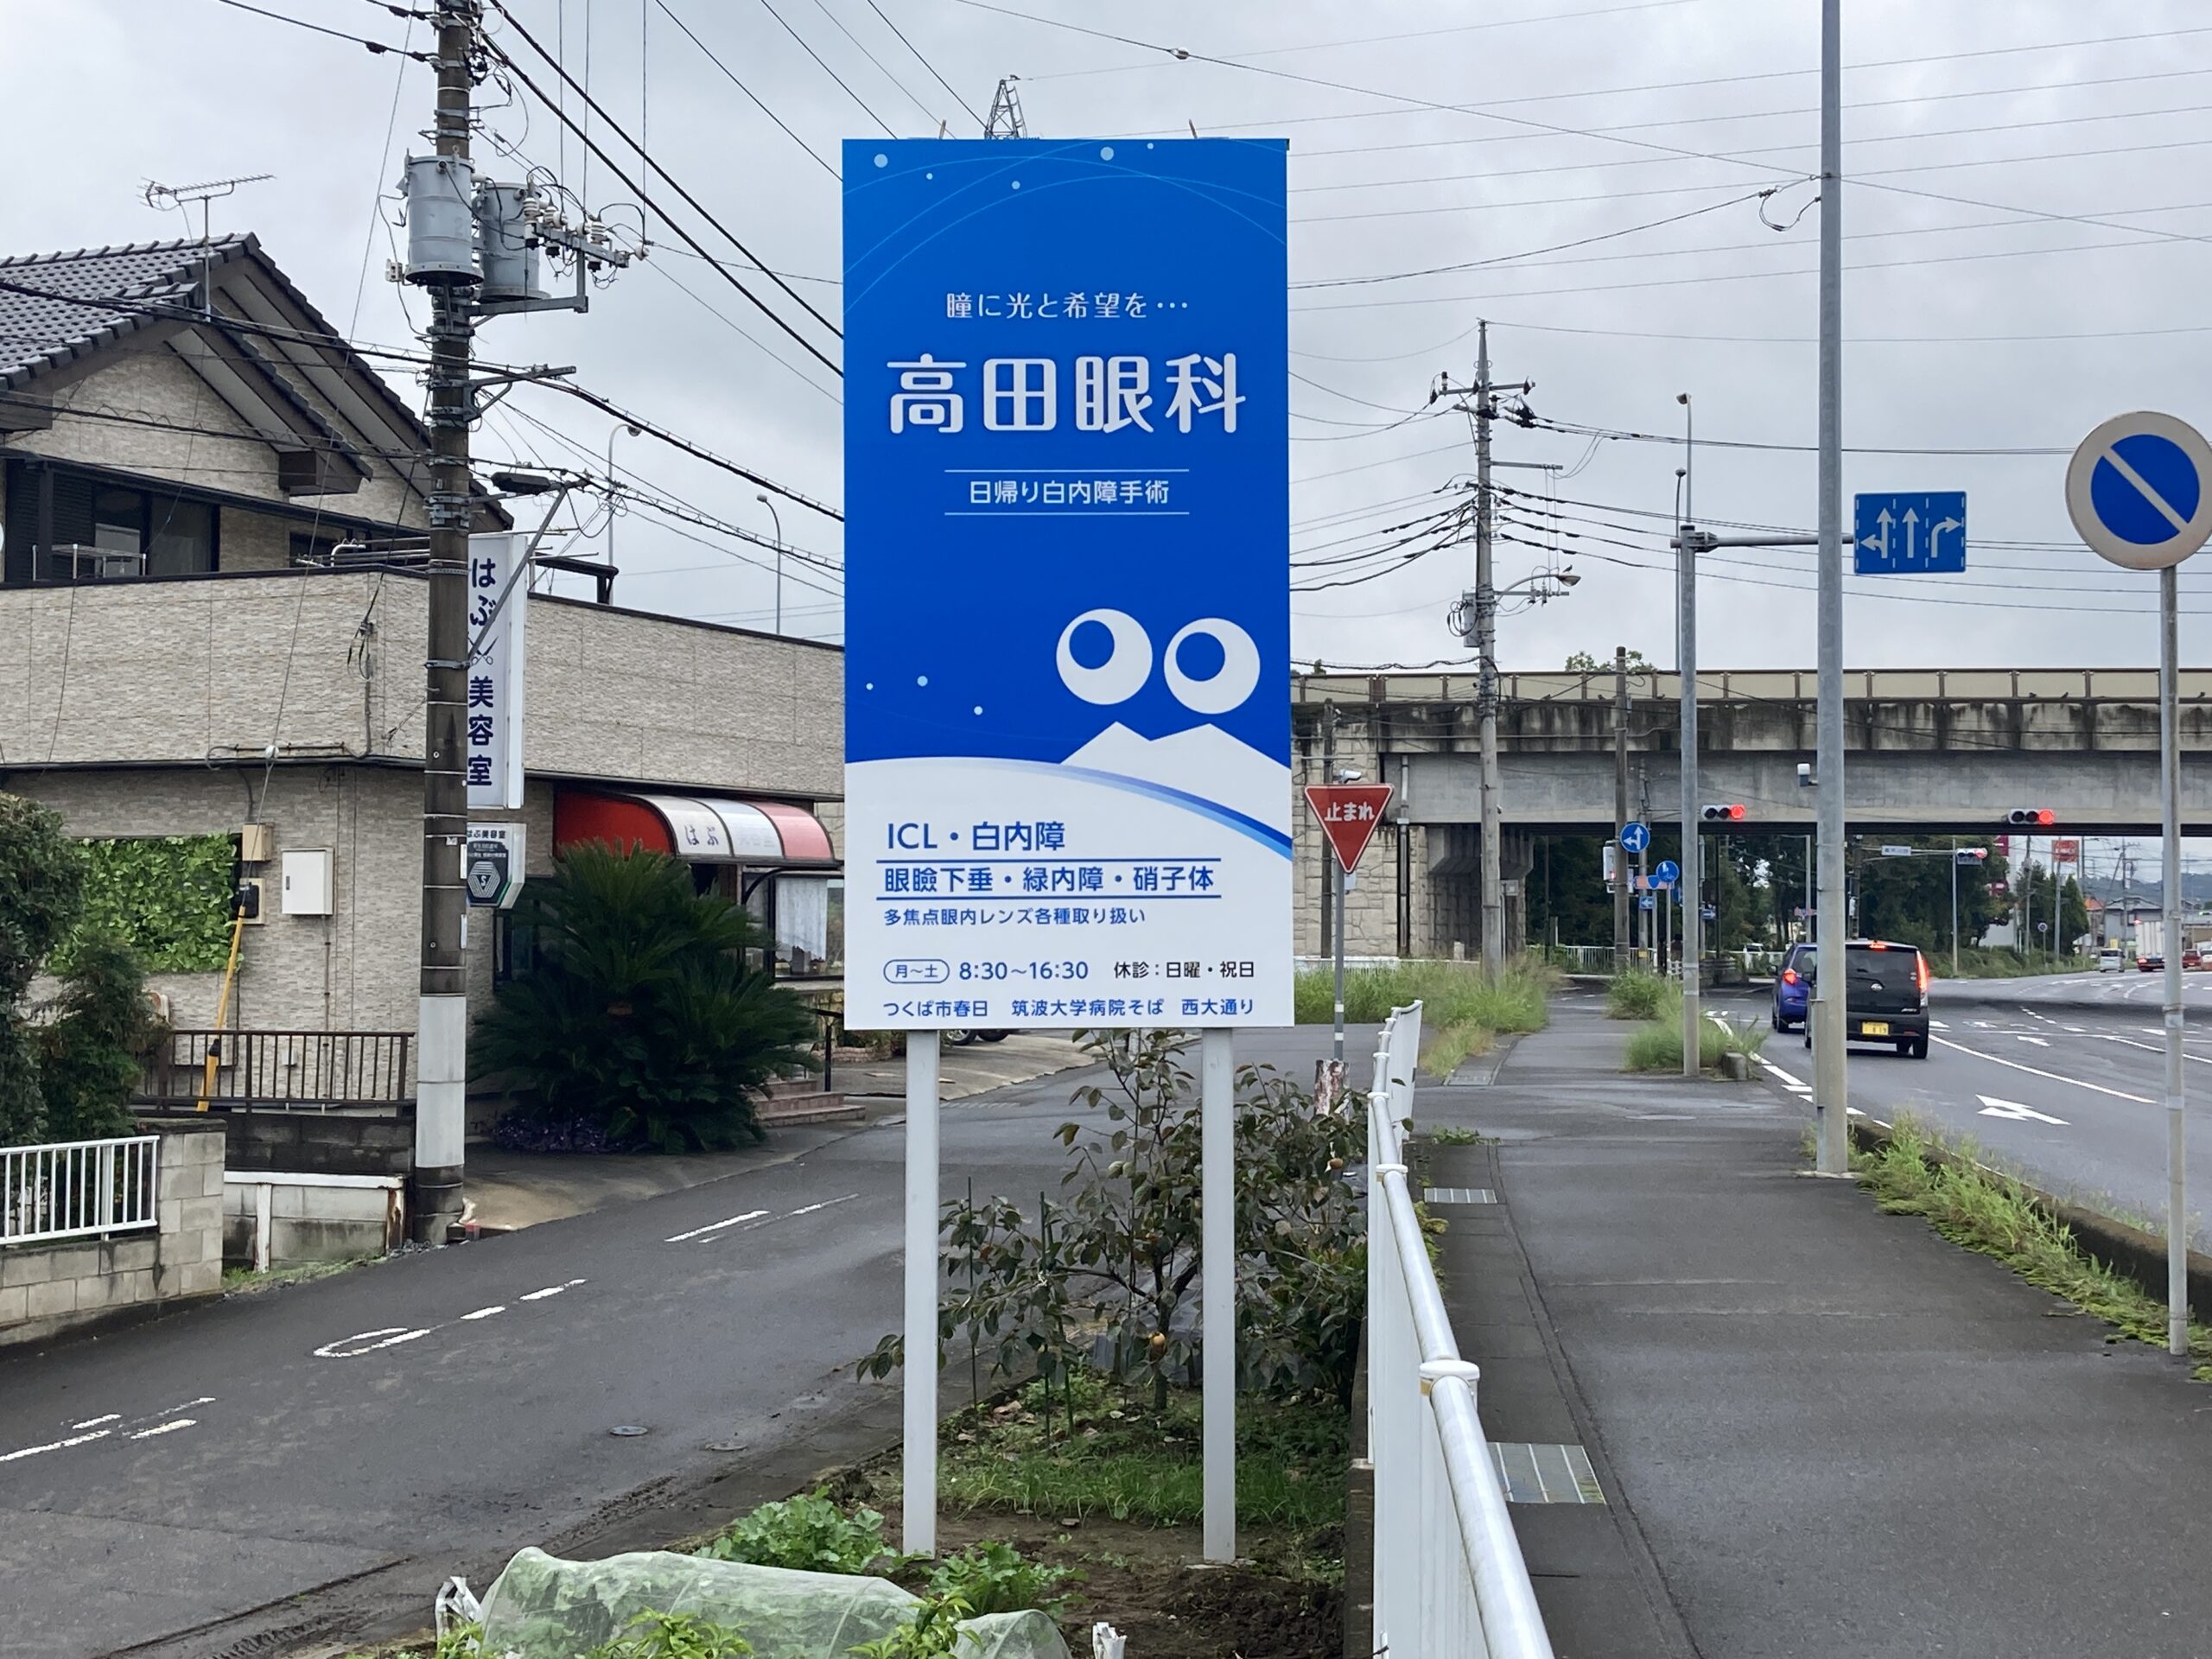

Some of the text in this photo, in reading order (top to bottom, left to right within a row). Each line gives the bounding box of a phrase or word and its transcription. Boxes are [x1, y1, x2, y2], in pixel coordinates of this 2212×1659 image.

[887, 353, 1246, 434] 高田眼科
[969, 480, 1169, 505] 日帰り白内障手術
[467, 675, 494, 786] 美容室
[1324, 801, 1376, 822] 止まれ
[888, 820, 1065, 852] ICL・白内障
[885, 865, 1215, 893] 眼瞼下垂・緑内障・硝子体
[884, 907, 1146, 926] 多焦点眼内レンズ各種取り扱い
[883, 998, 1254, 1018] つくば市春日 筑波大学病院そば 西大通り
